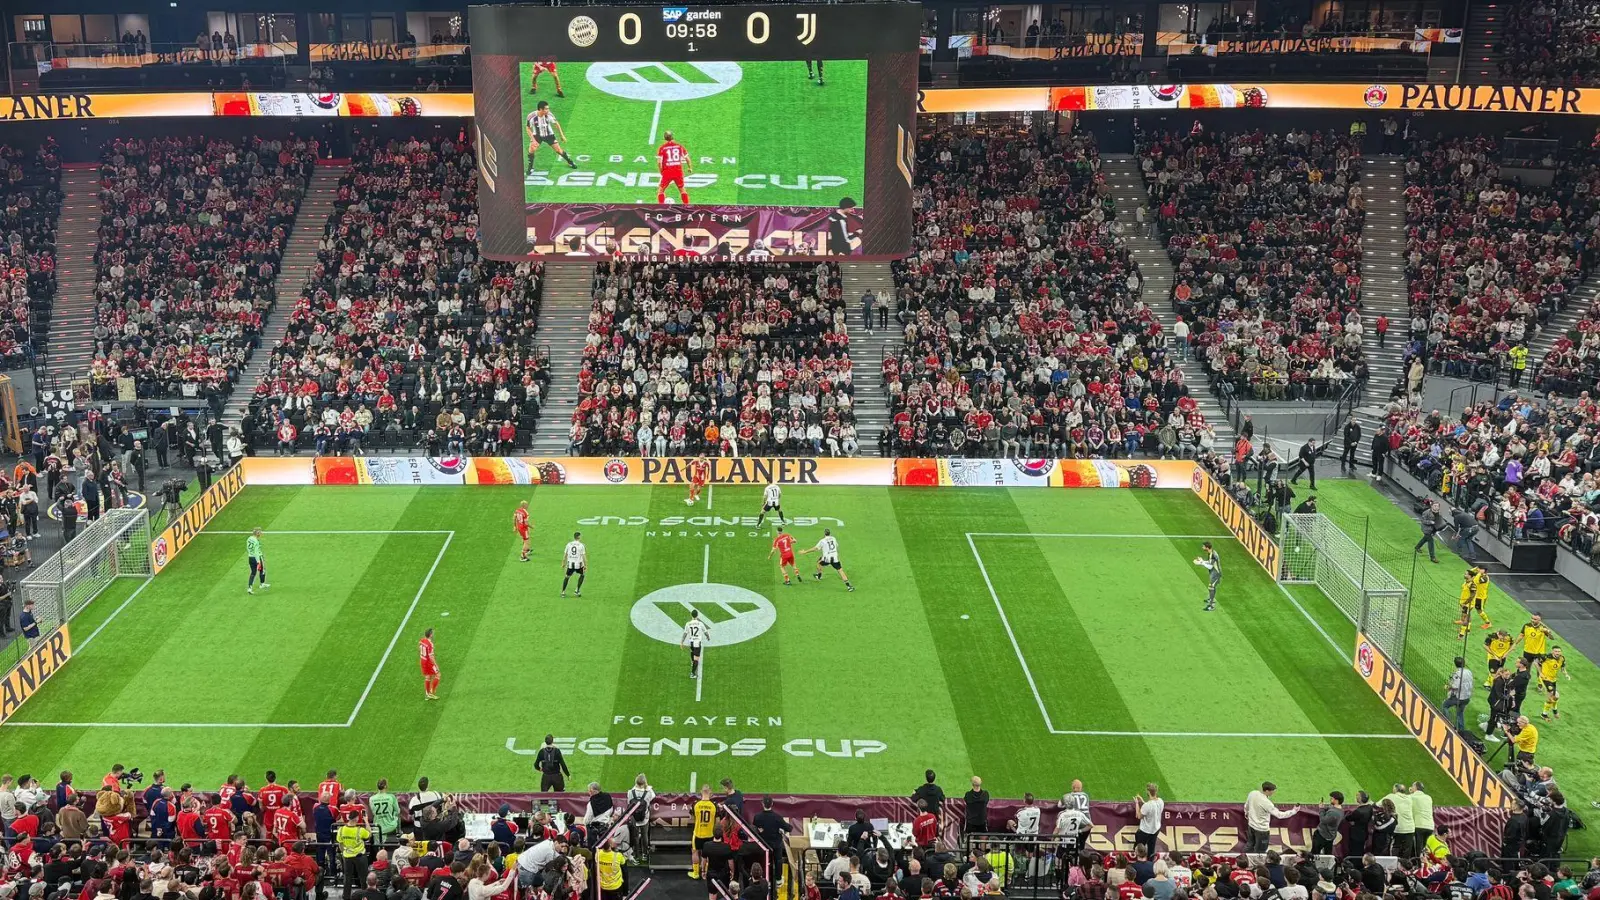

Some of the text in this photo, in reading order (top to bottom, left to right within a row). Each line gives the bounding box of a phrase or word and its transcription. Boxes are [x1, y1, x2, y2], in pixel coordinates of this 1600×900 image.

[663, 10, 721, 21] SAP garden
[618, 12, 642, 45] 0
[666, 23, 718, 39] 09:58
[746, 11, 770, 45] 0
[1400, 84, 1581, 113] PAULANER
[666, 149, 680, 162] 18
[734, 174, 848, 190] CUP
[644, 213, 742, 223] FC BAYERN
[641, 457, 820, 484] PAULANER
[171, 465, 245, 553] PAULANER
[1206, 476, 1276, 578] PAULANER
[571, 545, 578, 556] 9
[690, 626, 699, 637] 12
[613, 715, 783, 727] FC BAYERN
[505, 737, 888, 758] LEGENDS CUP
[268, 793, 277, 806] 9
[374, 801, 389, 816] 22
[1165, 811, 1230, 820] BAYERN
[210, 816, 218, 828] 9
[276, 816, 288, 831] 17
[700, 810, 711, 824] 10
[1028, 817, 1038, 830] 7
[1069, 818, 1078, 831] 3
